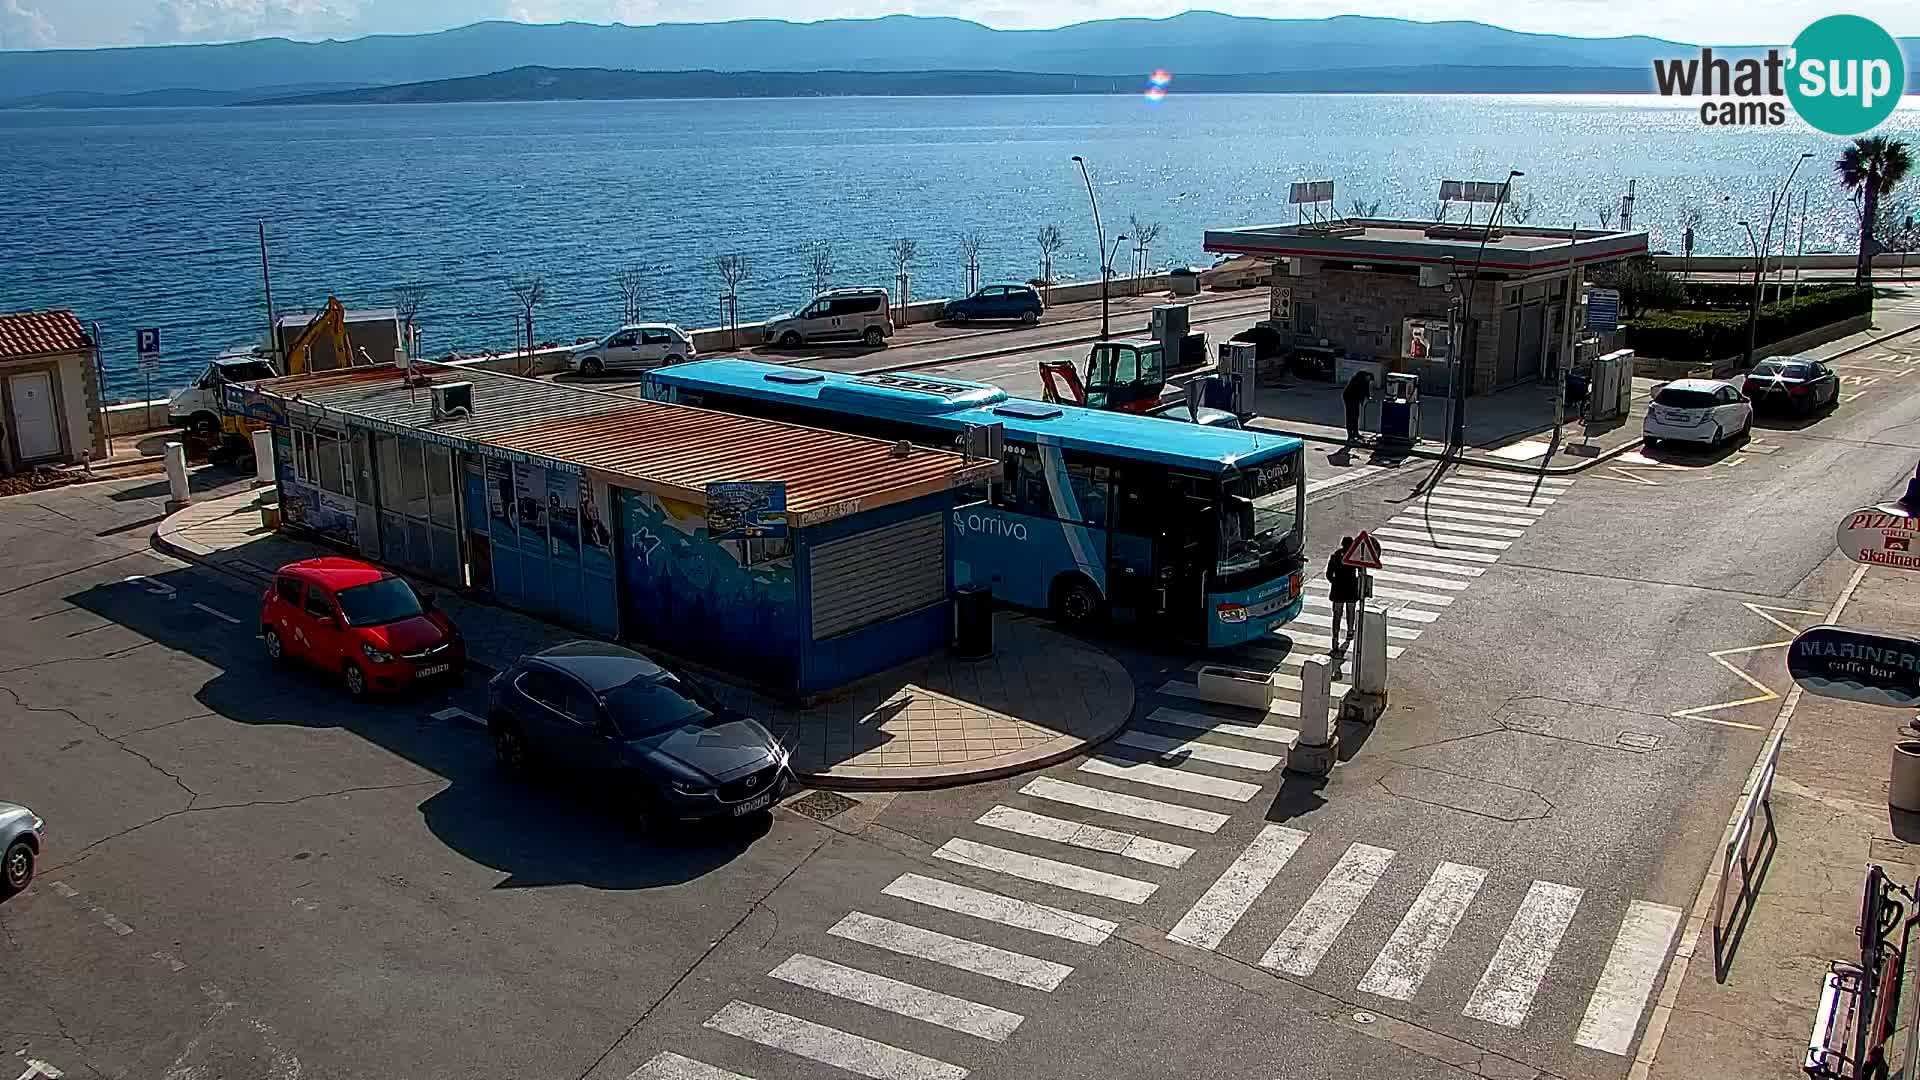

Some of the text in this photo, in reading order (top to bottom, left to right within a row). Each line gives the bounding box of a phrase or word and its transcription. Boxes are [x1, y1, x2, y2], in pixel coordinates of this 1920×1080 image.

[494, 447, 526, 464] STATION
[529, 455, 555, 470] TICKET
[555, 460, 583, 476] OFFICE
[968, 514, 1027, 540] arriva
[1848, 513, 1920, 532] PIZZE
[1828, 661, 1896, 678] caffe bar
